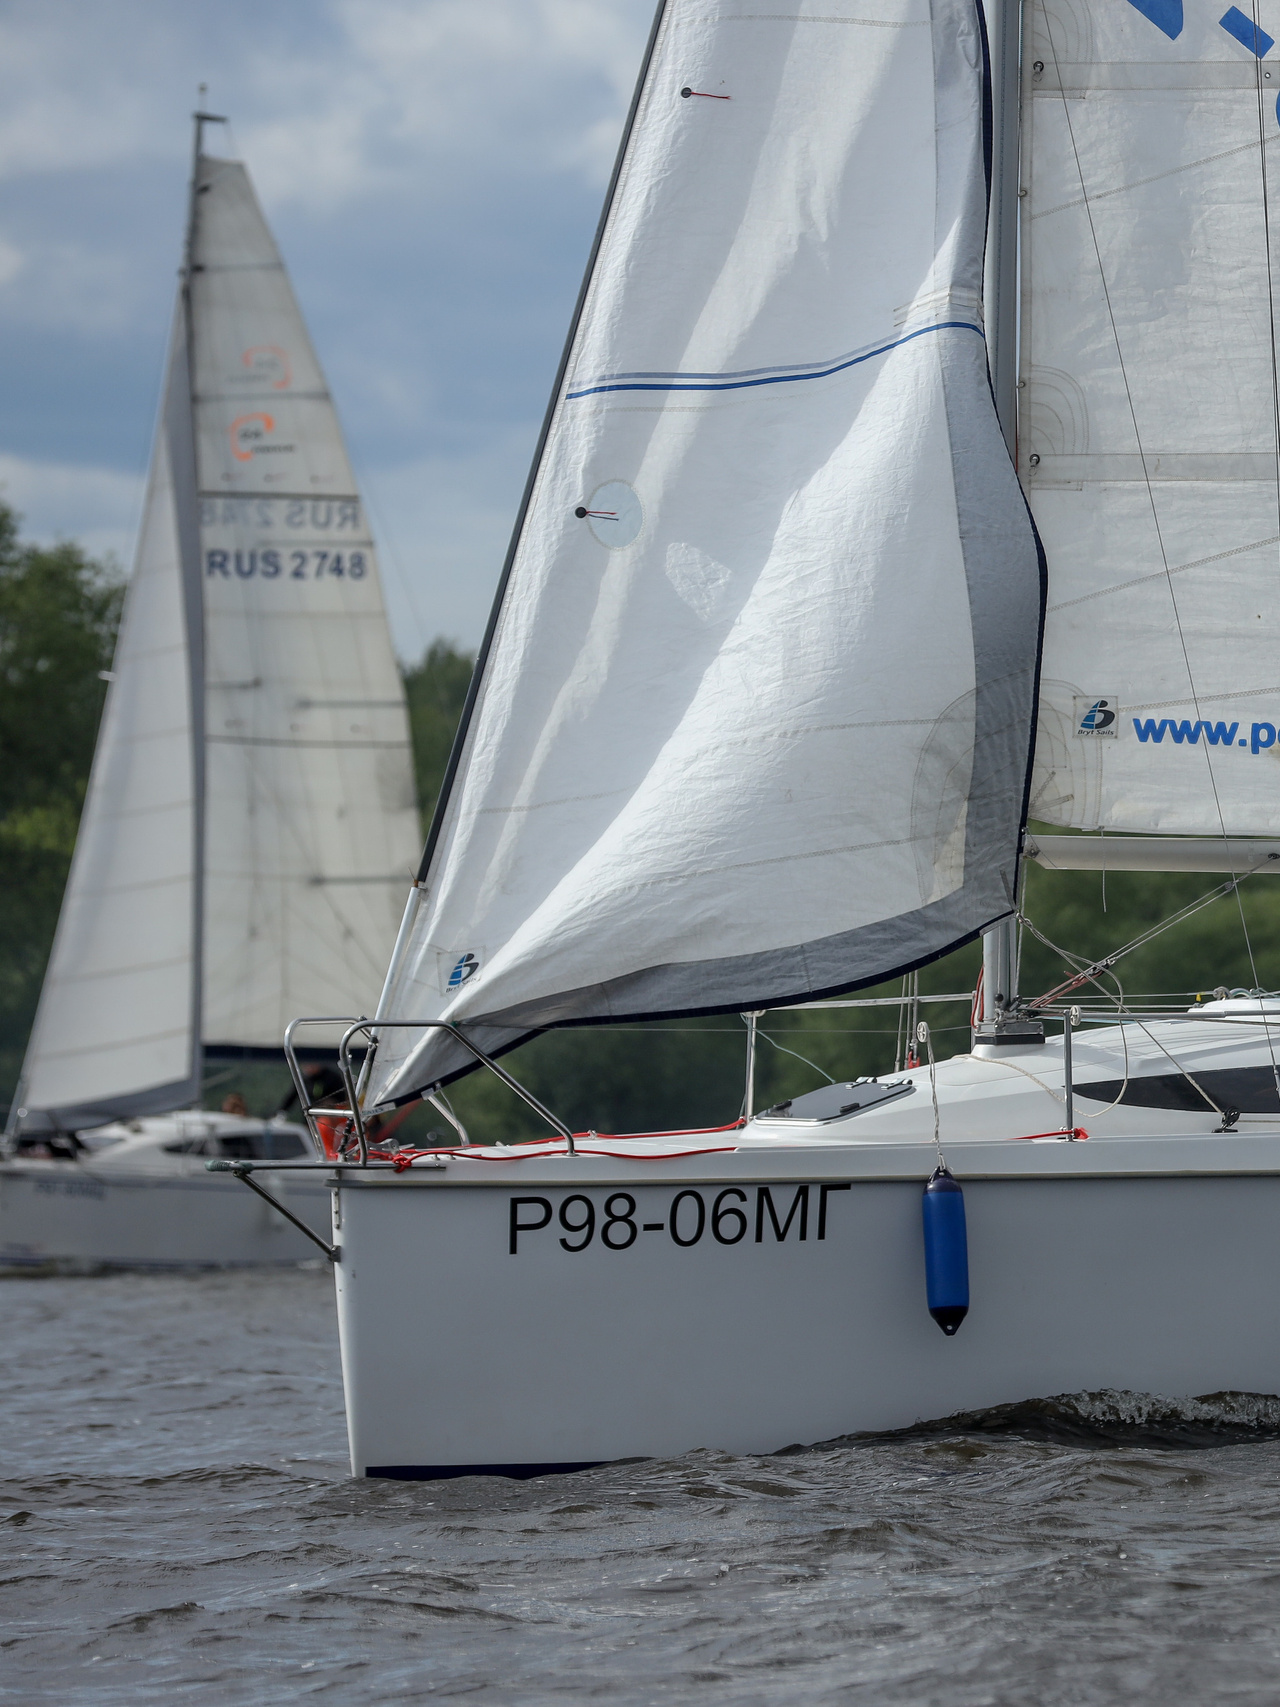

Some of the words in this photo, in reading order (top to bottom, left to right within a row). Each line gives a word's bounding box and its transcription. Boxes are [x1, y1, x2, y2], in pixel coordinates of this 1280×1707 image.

[205, 547, 282, 578] RUS
[290, 548, 368, 578] 2748
[508, 1183, 852, 1255] Р98-06МГ
